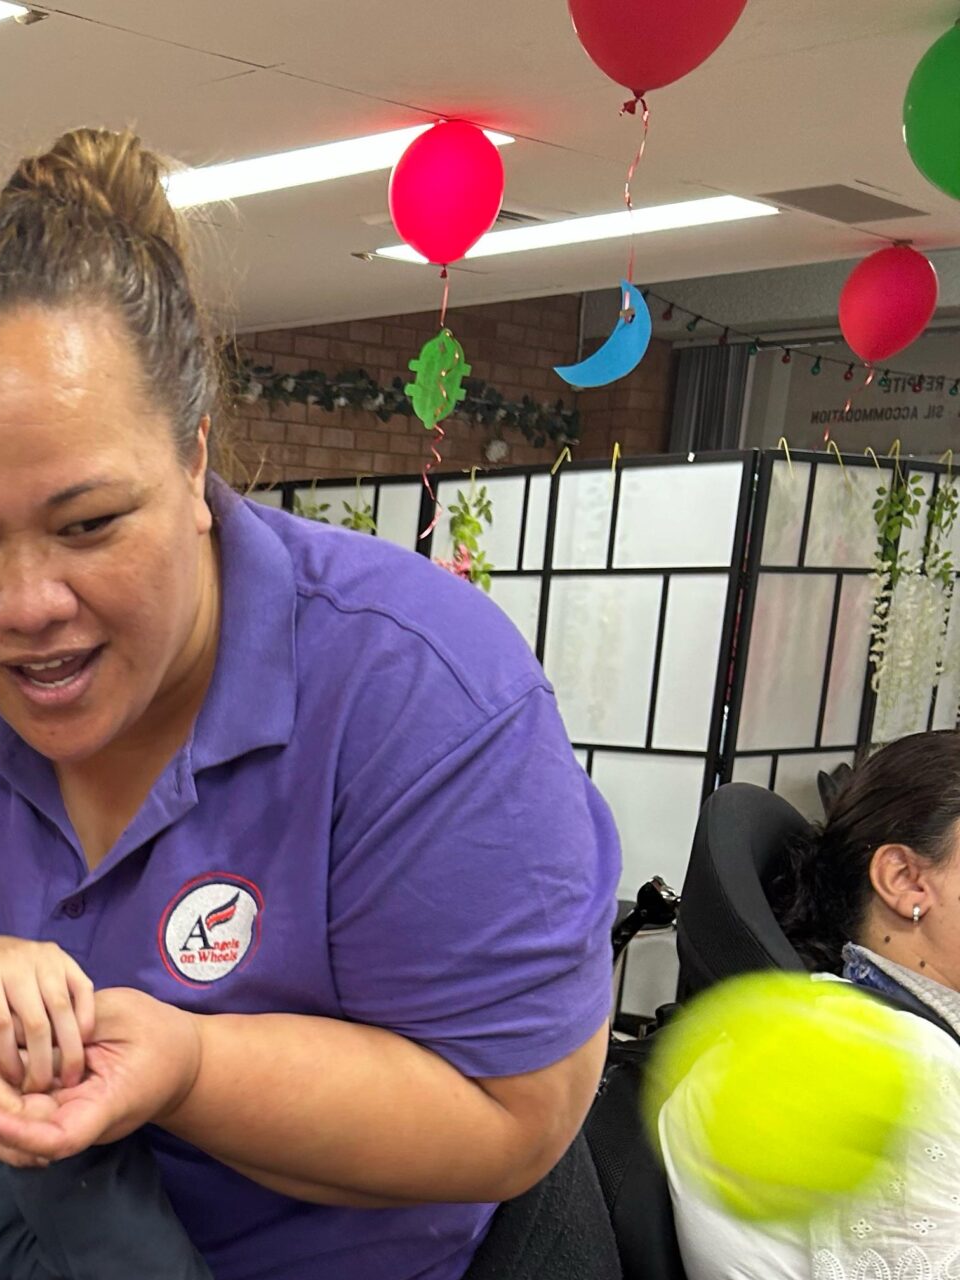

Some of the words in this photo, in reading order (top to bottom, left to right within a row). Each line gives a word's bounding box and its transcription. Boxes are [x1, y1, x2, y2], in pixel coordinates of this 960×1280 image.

[179, 913, 240, 952] Angels
[179, 954, 195, 964] on
[198, 950, 238, 963] Wheels
